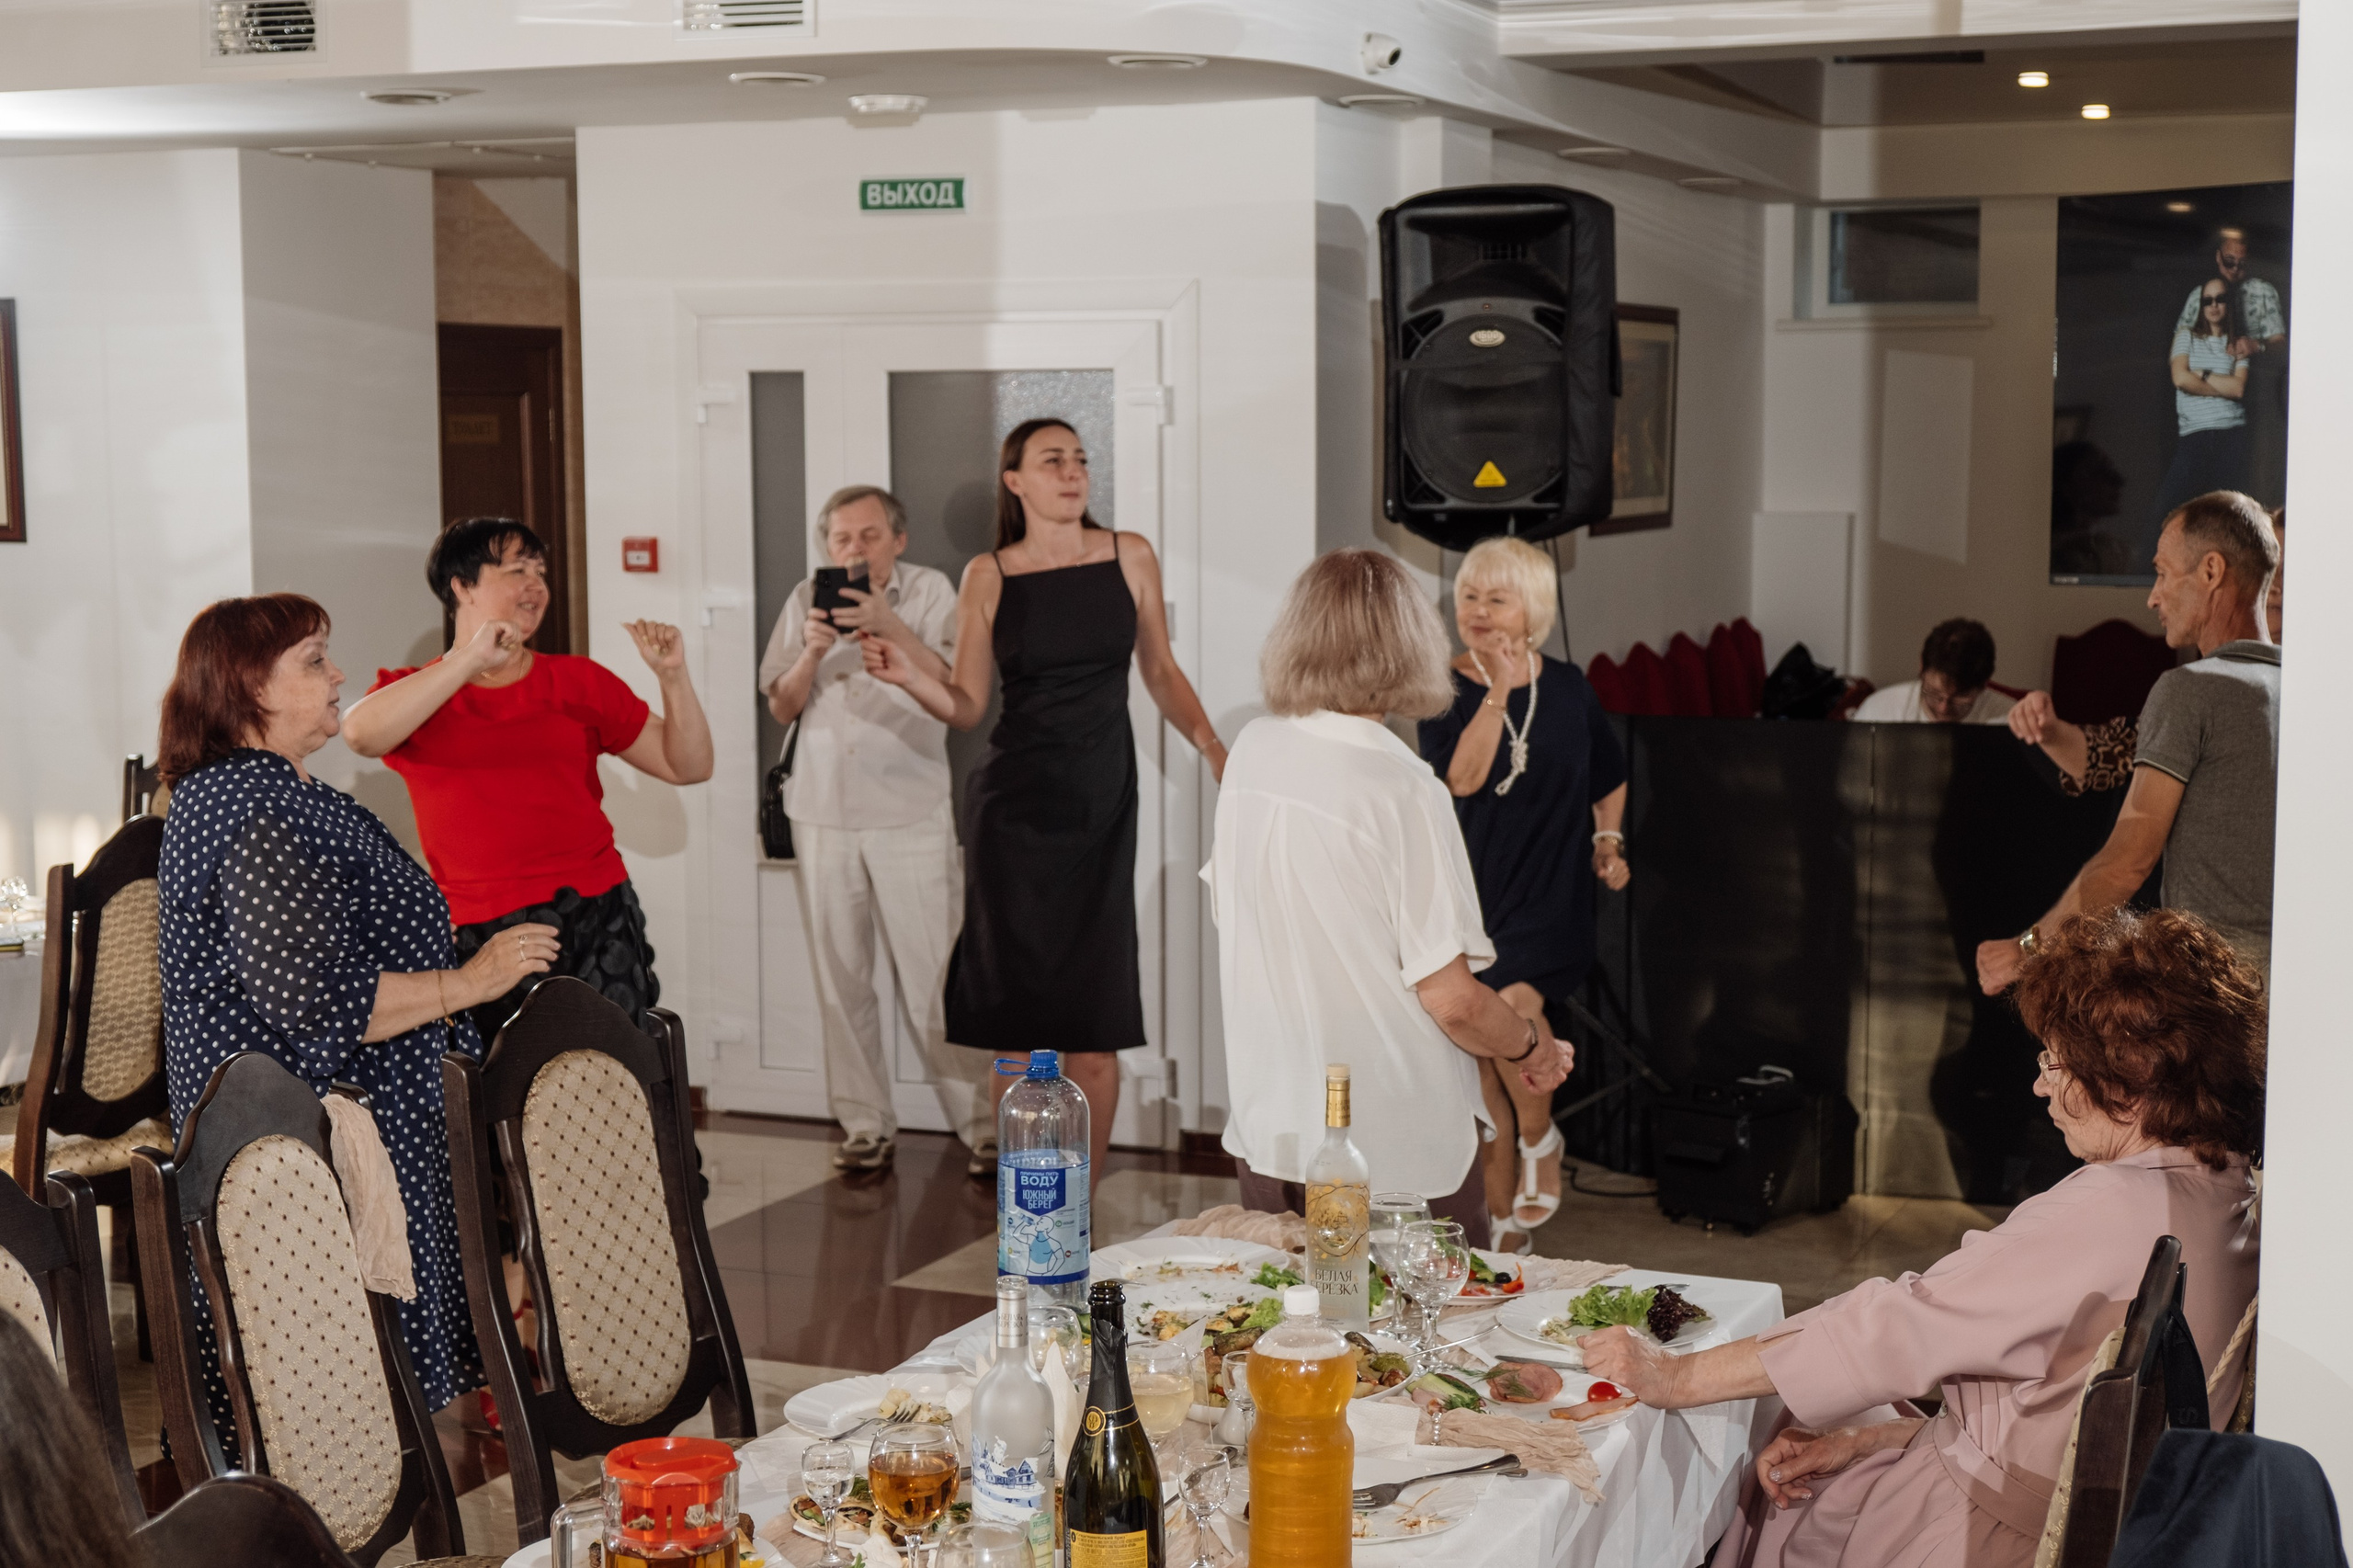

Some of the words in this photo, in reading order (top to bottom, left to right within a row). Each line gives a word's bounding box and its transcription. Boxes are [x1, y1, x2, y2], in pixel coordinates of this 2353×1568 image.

[866, 182, 957, 207] ВЫХОД
[1020, 1176, 1059, 1187] ВОДУ
[1022, 1187, 1057, 1200] ЮЖНЫЙ
[1028, 1199, 1054, 1210] БЕРЕГ
[1314, 1268, 1353, 1283] БЕЛАЯ
